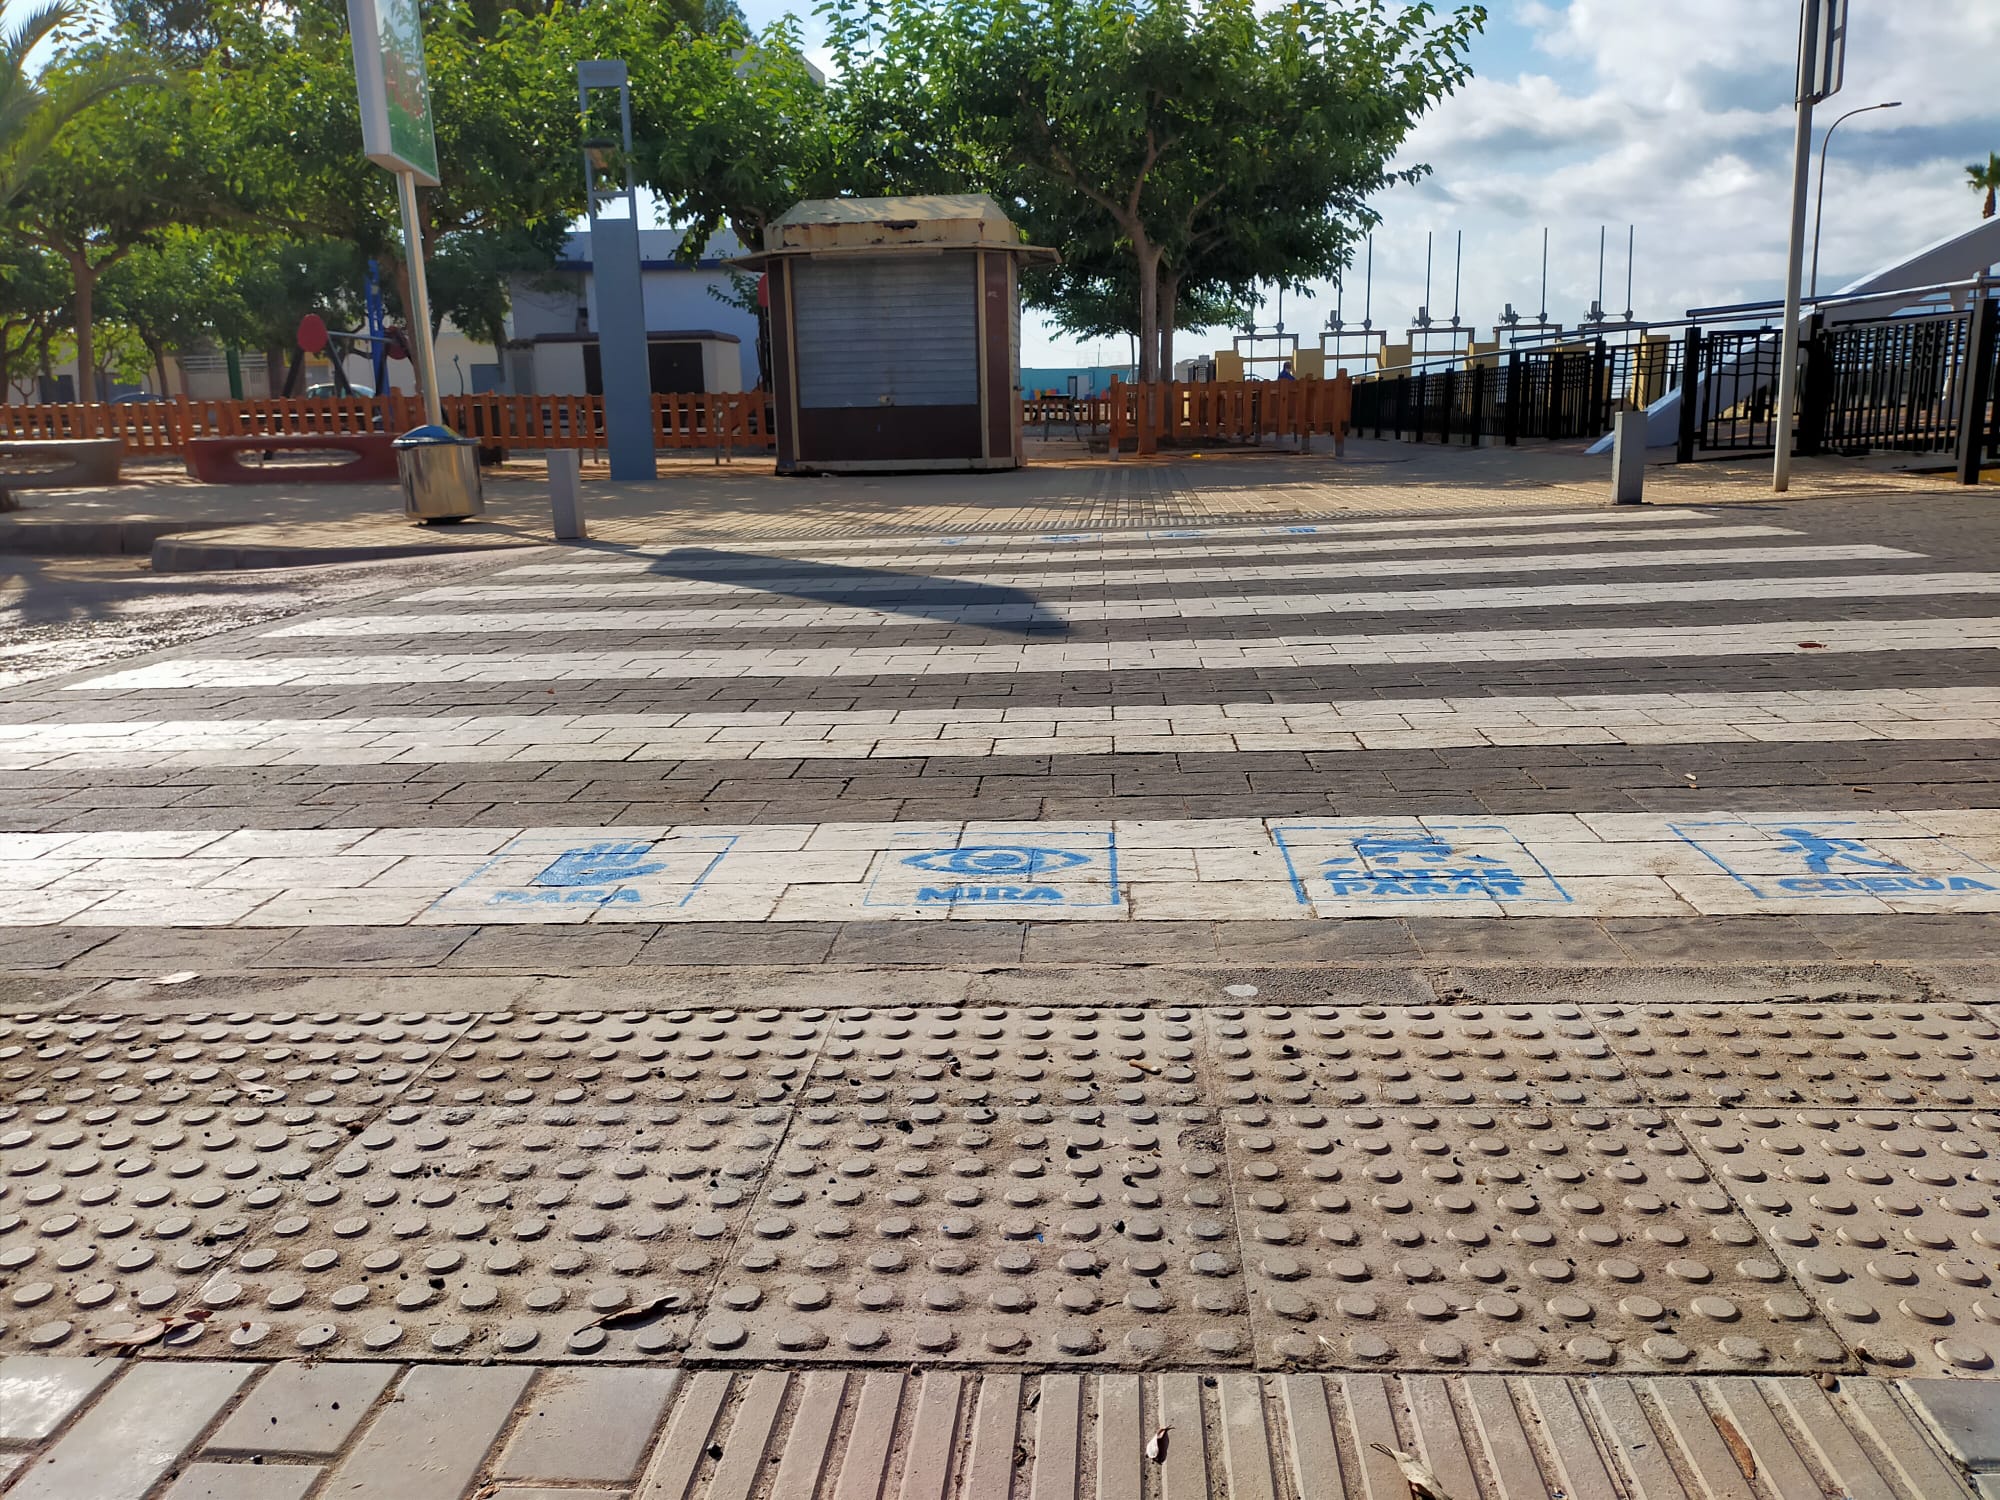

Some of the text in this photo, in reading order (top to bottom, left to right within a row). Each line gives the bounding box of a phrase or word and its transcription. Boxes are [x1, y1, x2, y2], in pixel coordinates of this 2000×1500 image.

[1323, 868, 1521, 881] COTXE
[1331, 881, 1526, 896] PARAT
[1777, 876, 2000, 892] CREUA
[916, 886, 1065, 901] MIRA
